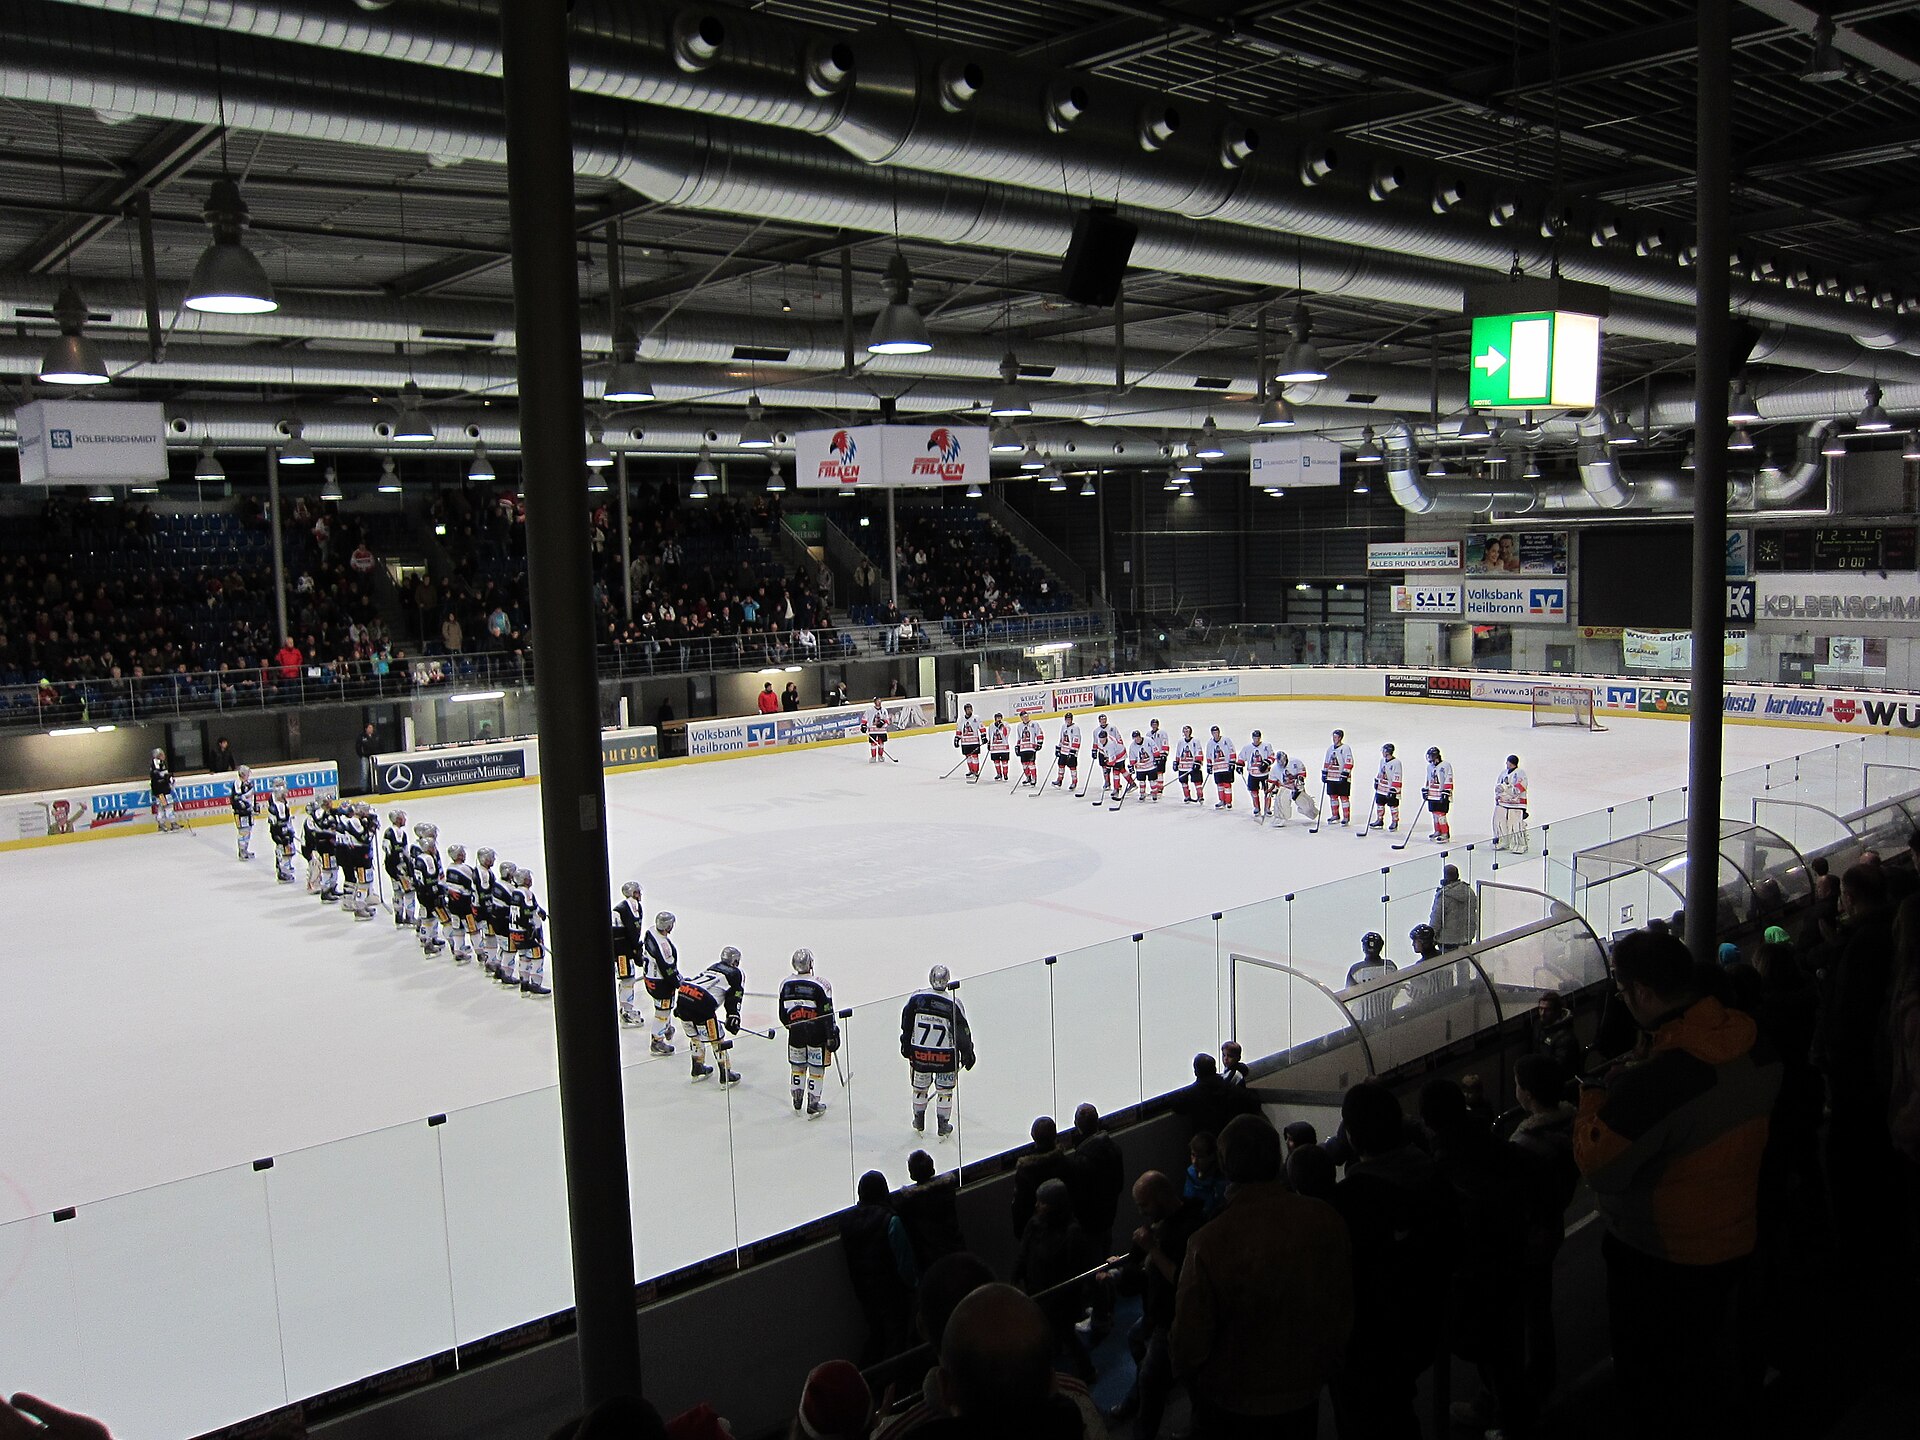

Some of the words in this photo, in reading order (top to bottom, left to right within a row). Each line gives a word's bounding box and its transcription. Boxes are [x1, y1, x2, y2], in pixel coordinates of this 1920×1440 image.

[1438, 559, 1459, 567] GLAS
[1416, 592, 1456, 607] SALZ
[1467, 589, 1523, 601] Volksbank
[1467, 603, 1524, 613] Heilbronn
[1057, 692, 1093, 704] KRITTER
[1110, 680, 1151, 703] HVG
[1764, 694, 1824, 717] hardusch
[691, 727, 743, 742] Volksbank
[691, 740, 743, 755] Heilbronn
[436, 753, 503, 769] Mercedes-Benz
[98, 795, 129, 809] DIE
[295, 770, 336, 787] GUT!
[917, 1022, 946, 1047] 77
